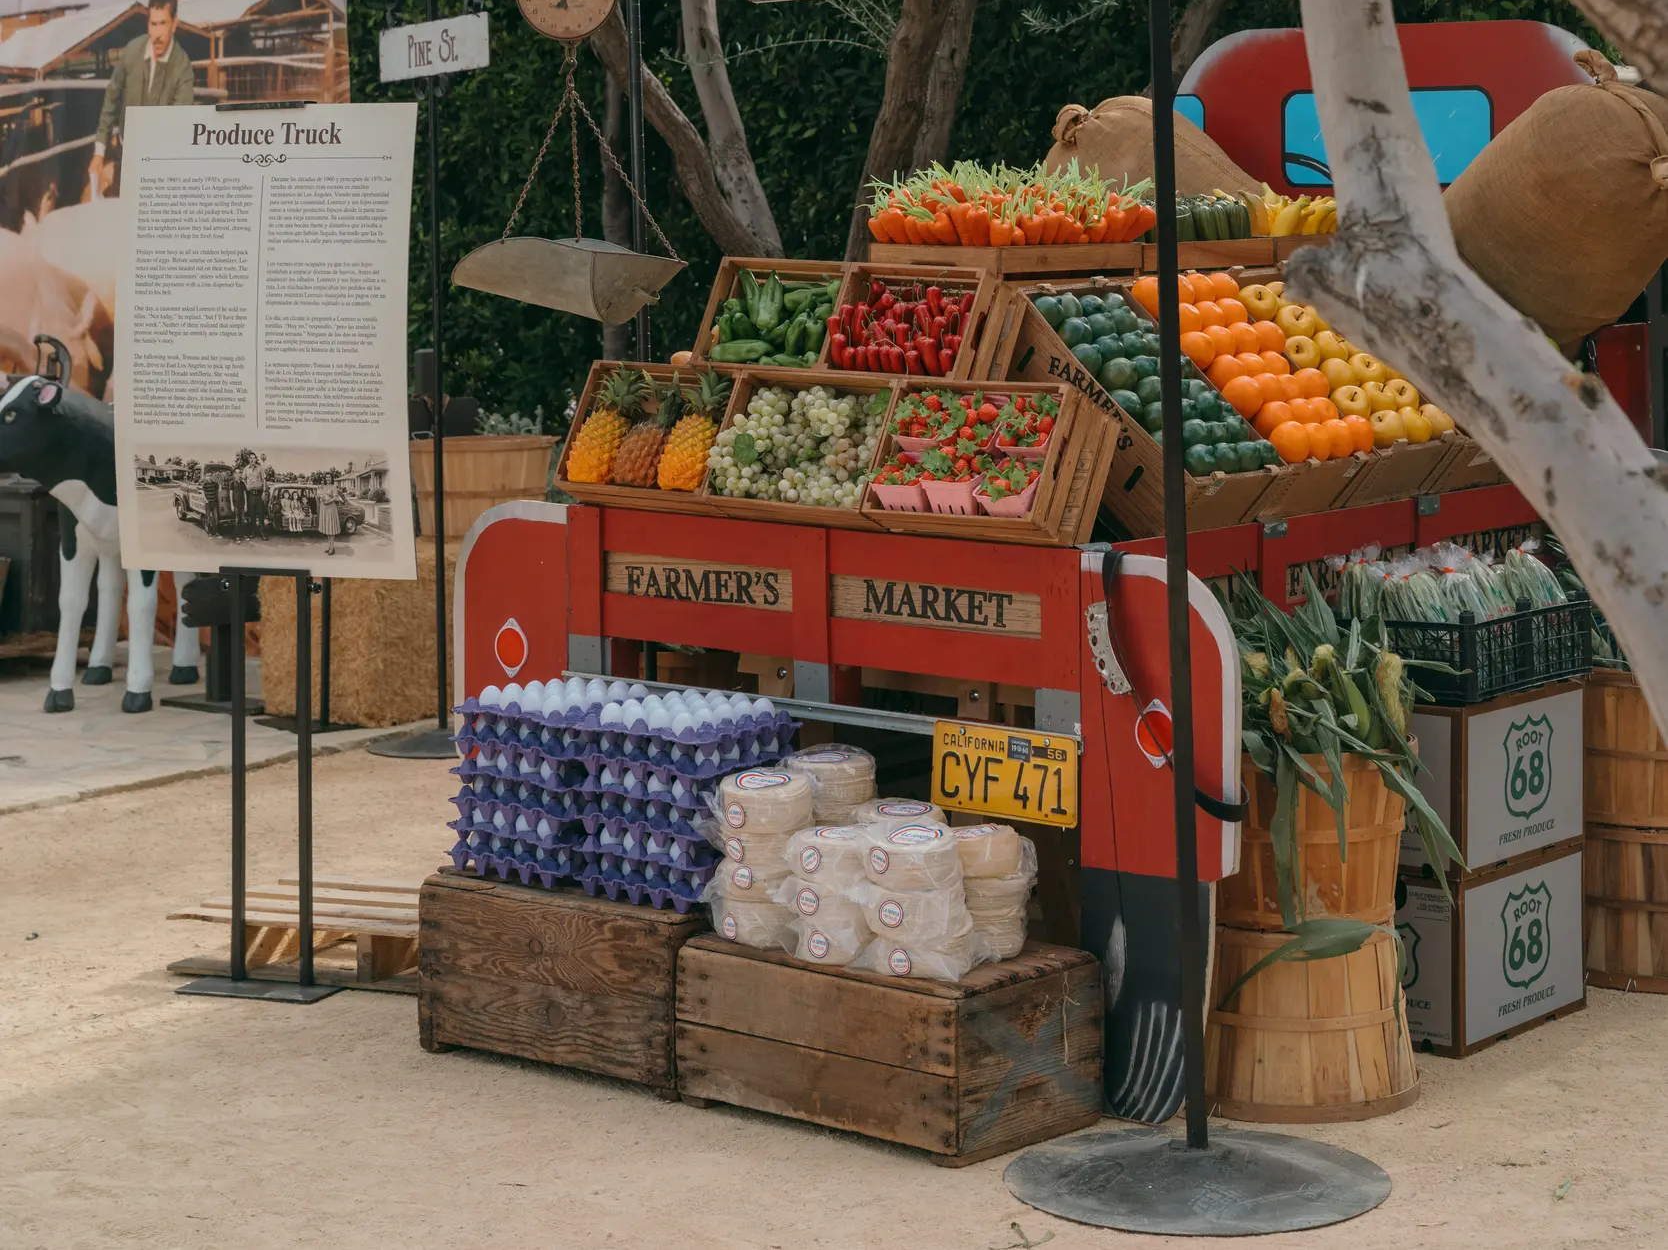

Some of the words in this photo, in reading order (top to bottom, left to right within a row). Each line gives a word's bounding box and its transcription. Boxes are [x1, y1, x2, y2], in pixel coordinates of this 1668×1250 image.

[408, 34, 432, 68] PINE
[439, 28, 458, 63] ST.
[191, 122, 274, 146] Produce
[281, 122, 342, 145] Truck
[624, 564, 780, 606] FARMER'S
[863, 578, 1013, 629] MARKET
[943, 732, 1005, 753] CALIFORNIA
[1047, 750, 1063, 760] 56
[1516, 730, 1544, 752] ROOT
[940, 751, 1003, 803] CYF
[1014, 762, 1067, 815] 471
[1510, 750, 1544, 800] 68
[1498, 828, 1522, 846] FRESH
[1523, 818, 1555, 837] PRODUCE
[1513, 898, 1542, 922] ROOT
[1508, 918, 1543, 971] 68
[1498, 999, 1523, 1017] FRESH
[1523, 985, 1555, 1007] PRODUCE
